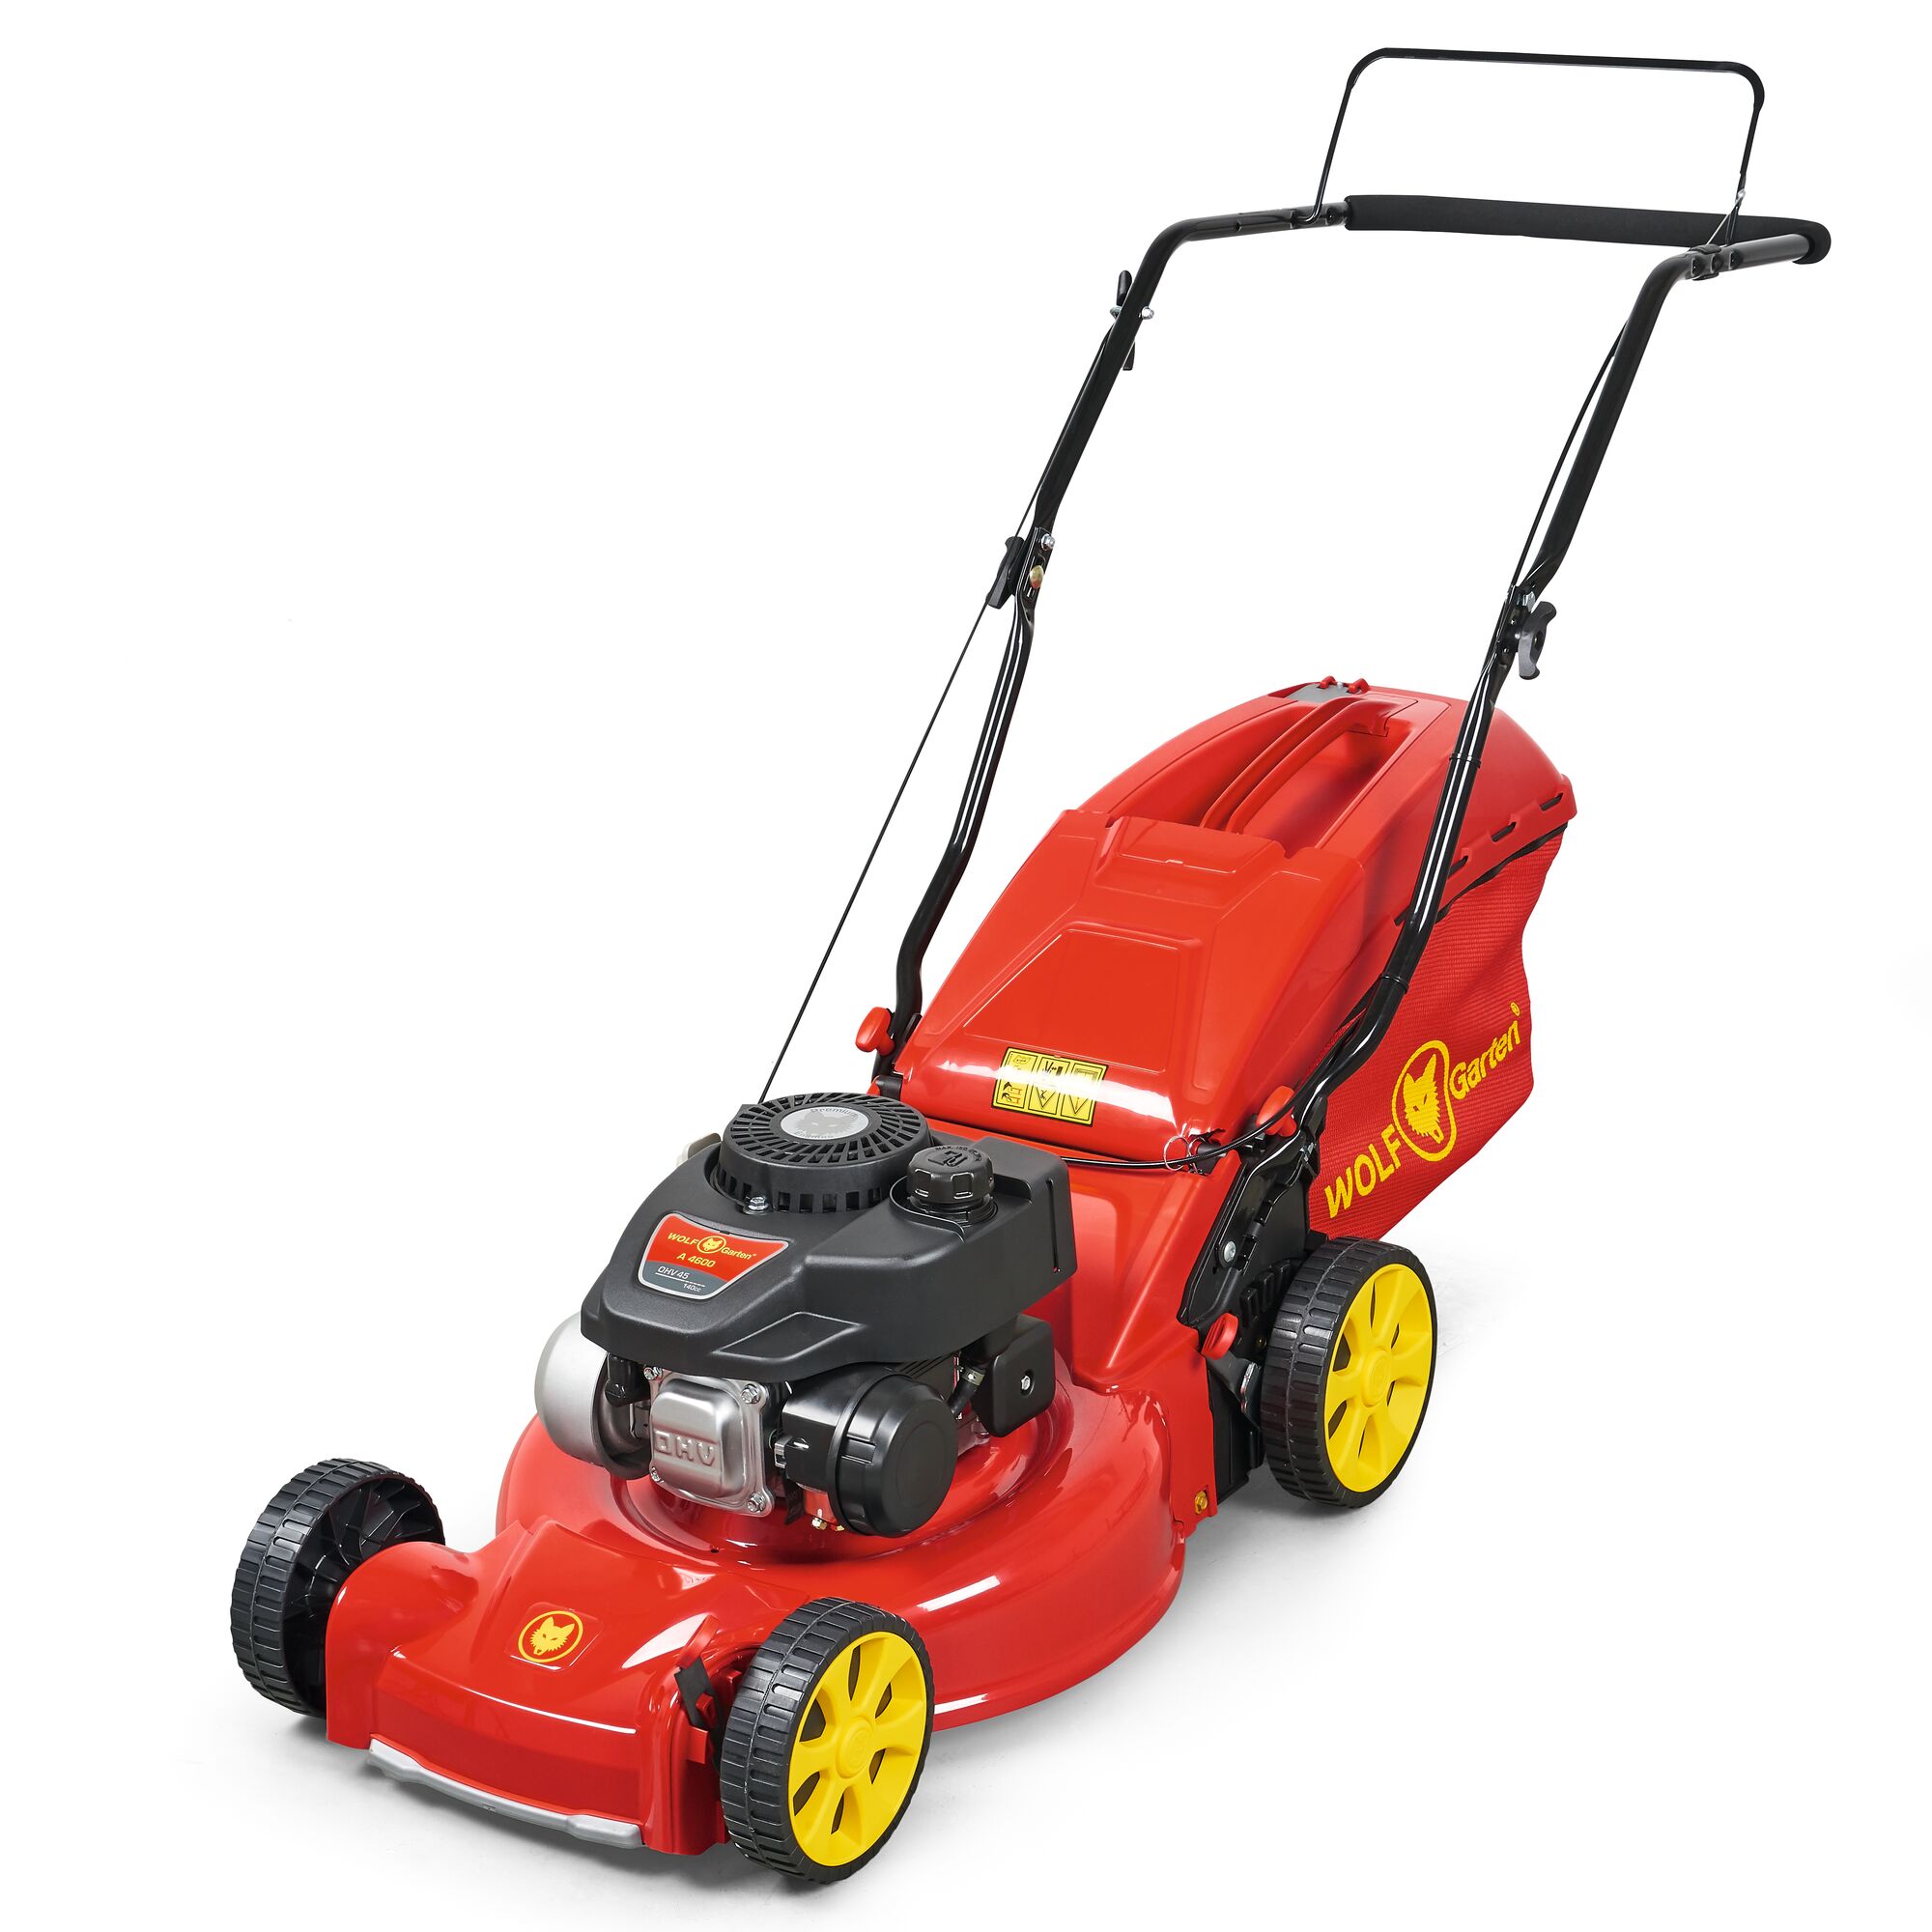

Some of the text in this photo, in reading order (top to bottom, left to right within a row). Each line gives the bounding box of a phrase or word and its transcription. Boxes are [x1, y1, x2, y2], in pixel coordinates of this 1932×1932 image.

[1324, 1123, 1402, 1219] WOLF
[668, 1232, 699, 1246] WOLF
[676, 1252, 716, 1268] A 4600
[677, 1271, 690, 1280] 45
[683, 1282, 702, 1293] 140cc
[654, 1430, 717, 1467] OHV
